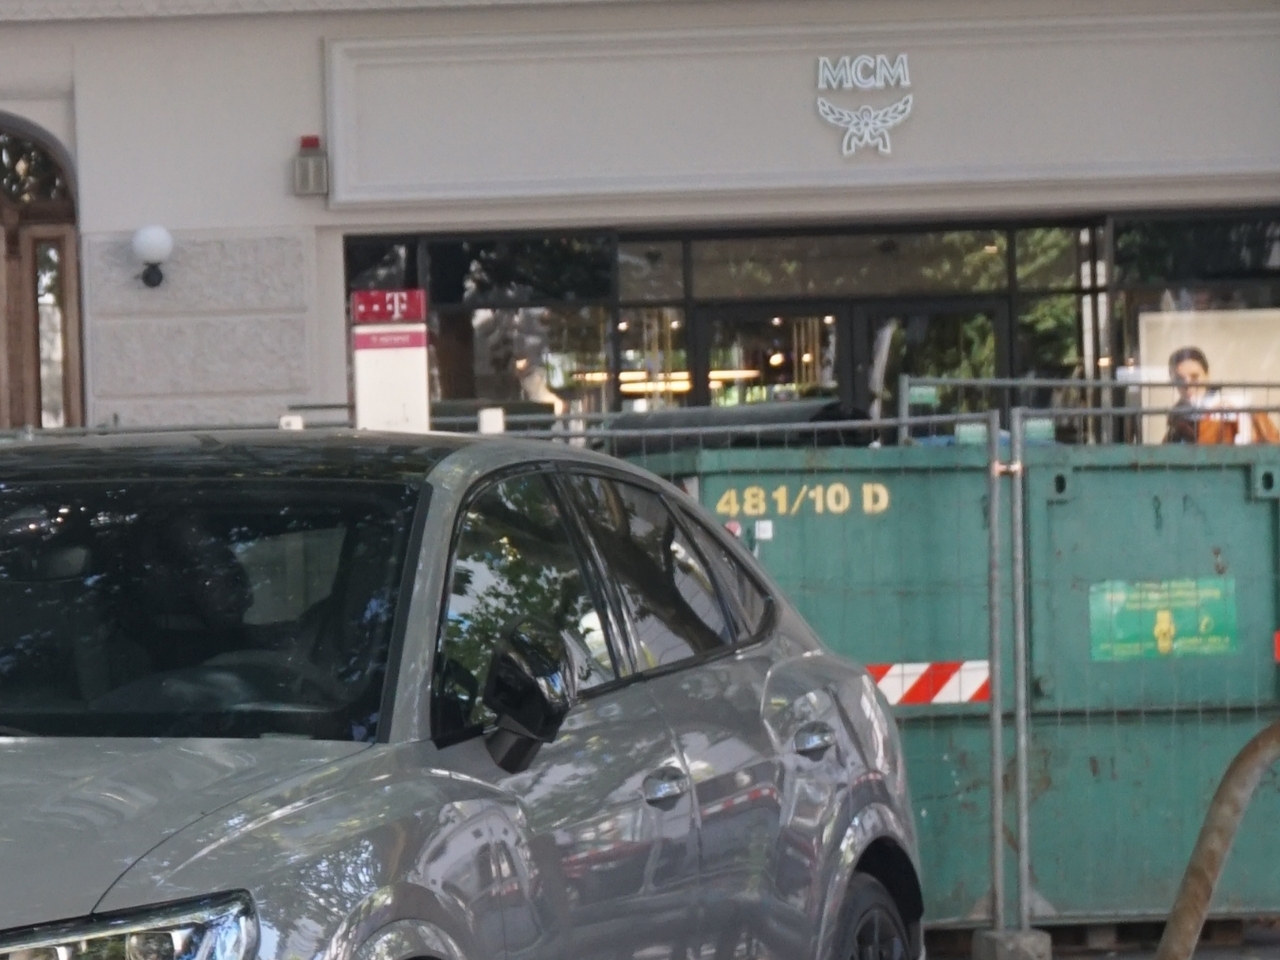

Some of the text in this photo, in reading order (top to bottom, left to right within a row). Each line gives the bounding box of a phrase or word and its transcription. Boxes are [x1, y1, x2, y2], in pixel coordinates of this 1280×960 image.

[817, 53, 911, 89] MCM
[715, 482, 890, 518] 481/10 D
